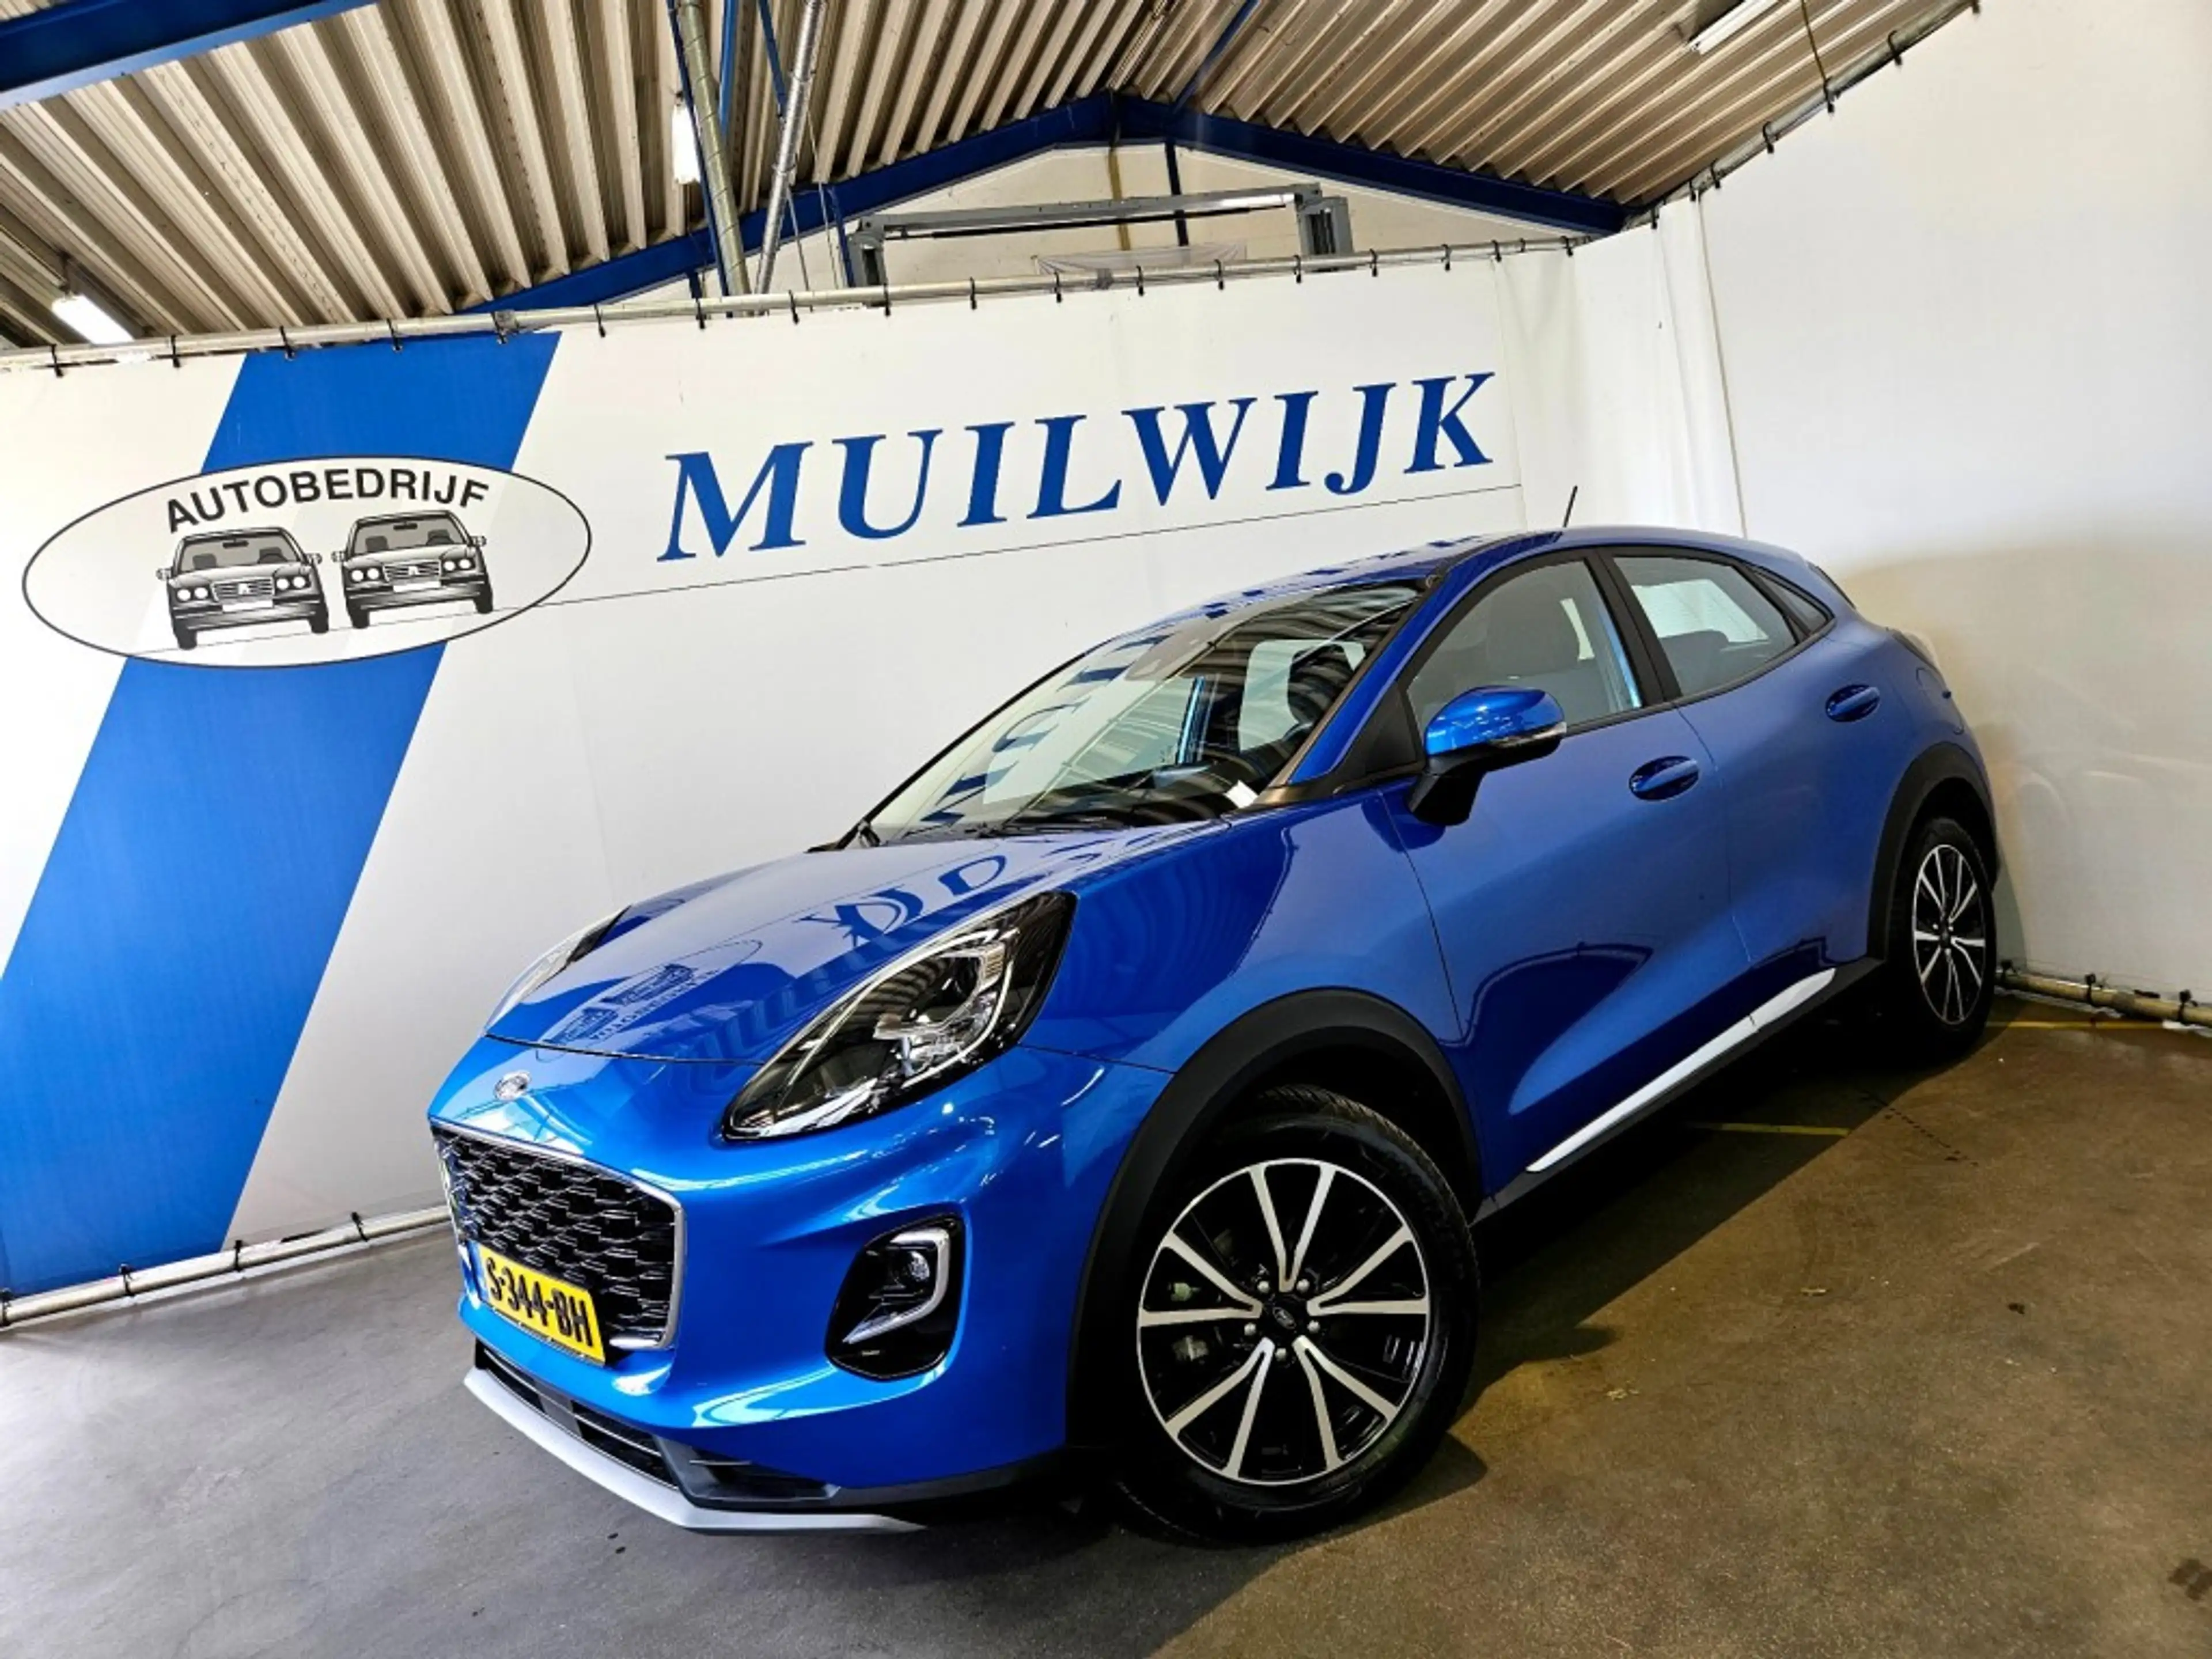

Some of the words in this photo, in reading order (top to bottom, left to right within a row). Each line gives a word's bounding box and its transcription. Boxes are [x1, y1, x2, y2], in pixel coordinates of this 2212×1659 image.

[167, 468, 489, 533] AUTOBEDRIJF
[657, 372, 1495, 562] MUILWIJK
[487, 1257, 593, 1347] S-344-BH
